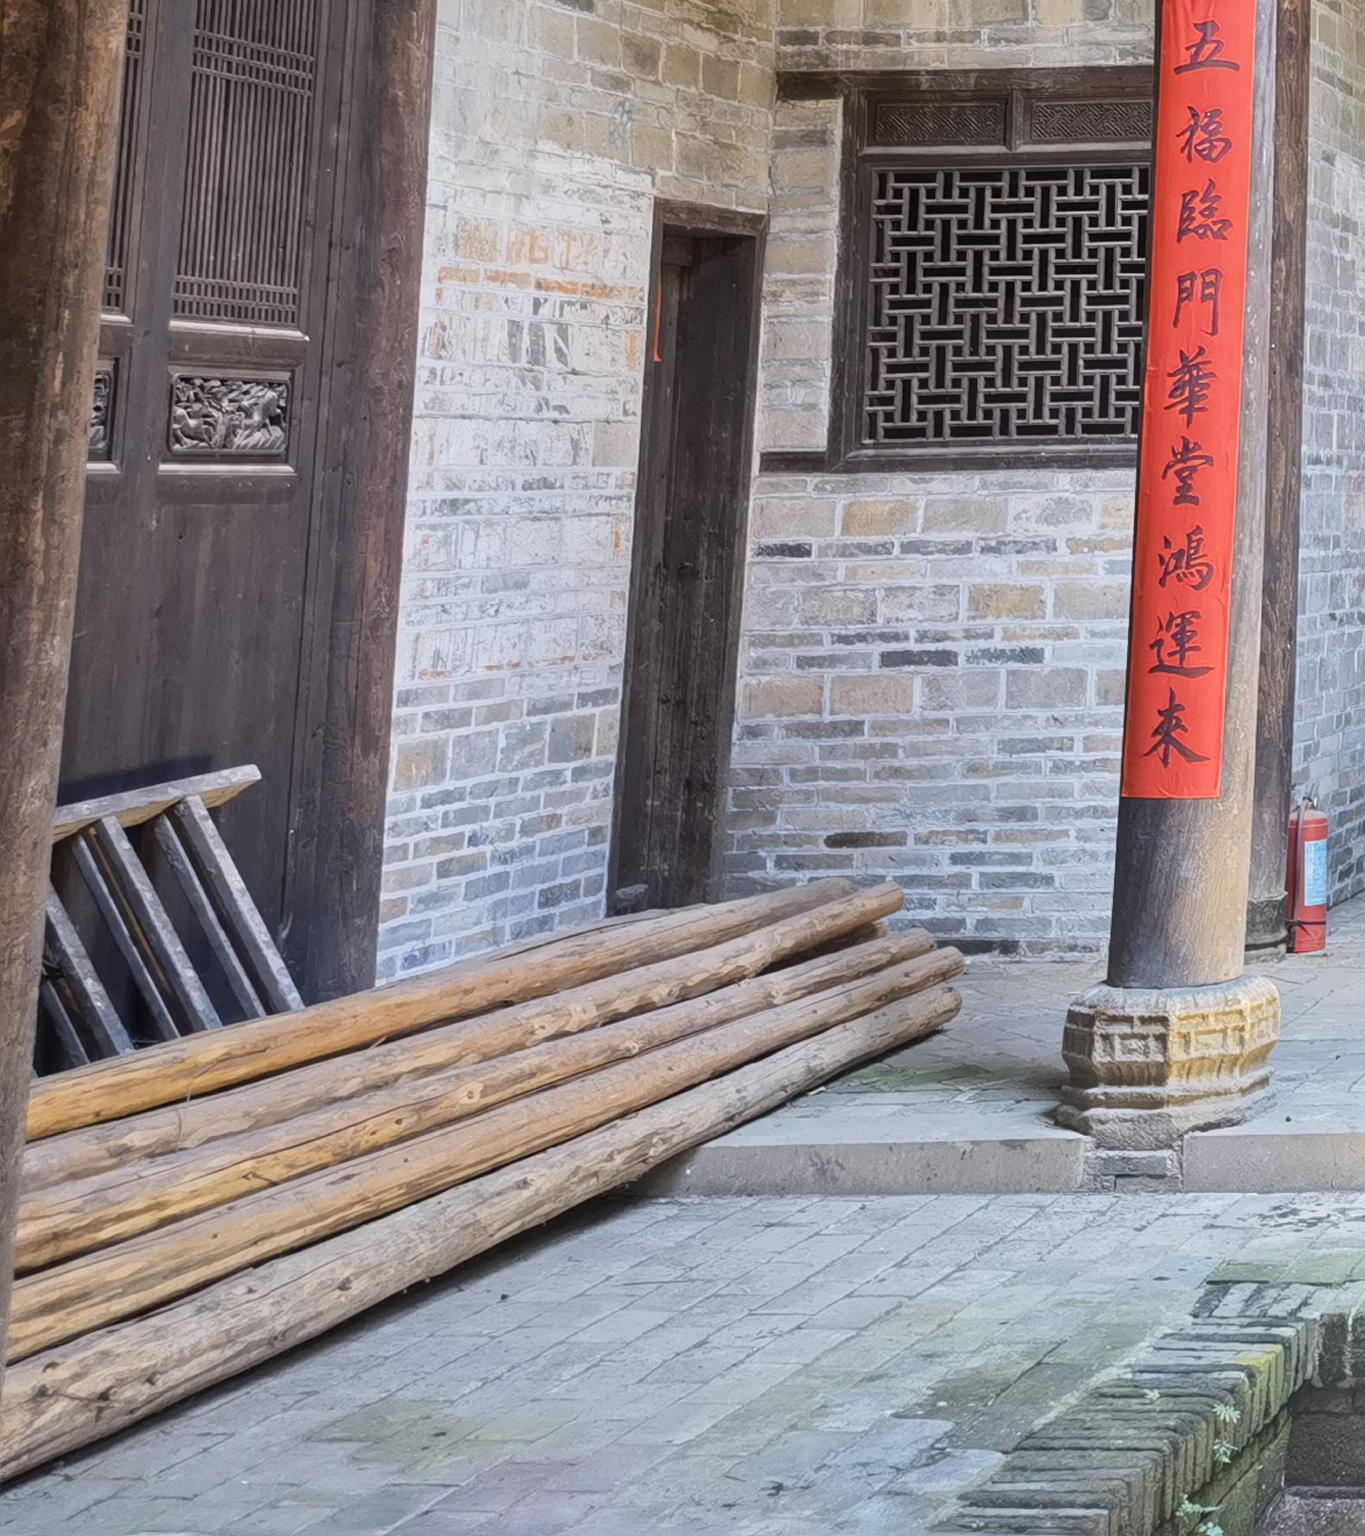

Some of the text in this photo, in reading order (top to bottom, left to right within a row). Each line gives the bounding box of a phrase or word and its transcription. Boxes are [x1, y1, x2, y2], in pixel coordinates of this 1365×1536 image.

[1142, 20, 1241, 766] 五福臨門華堂鴻運來
